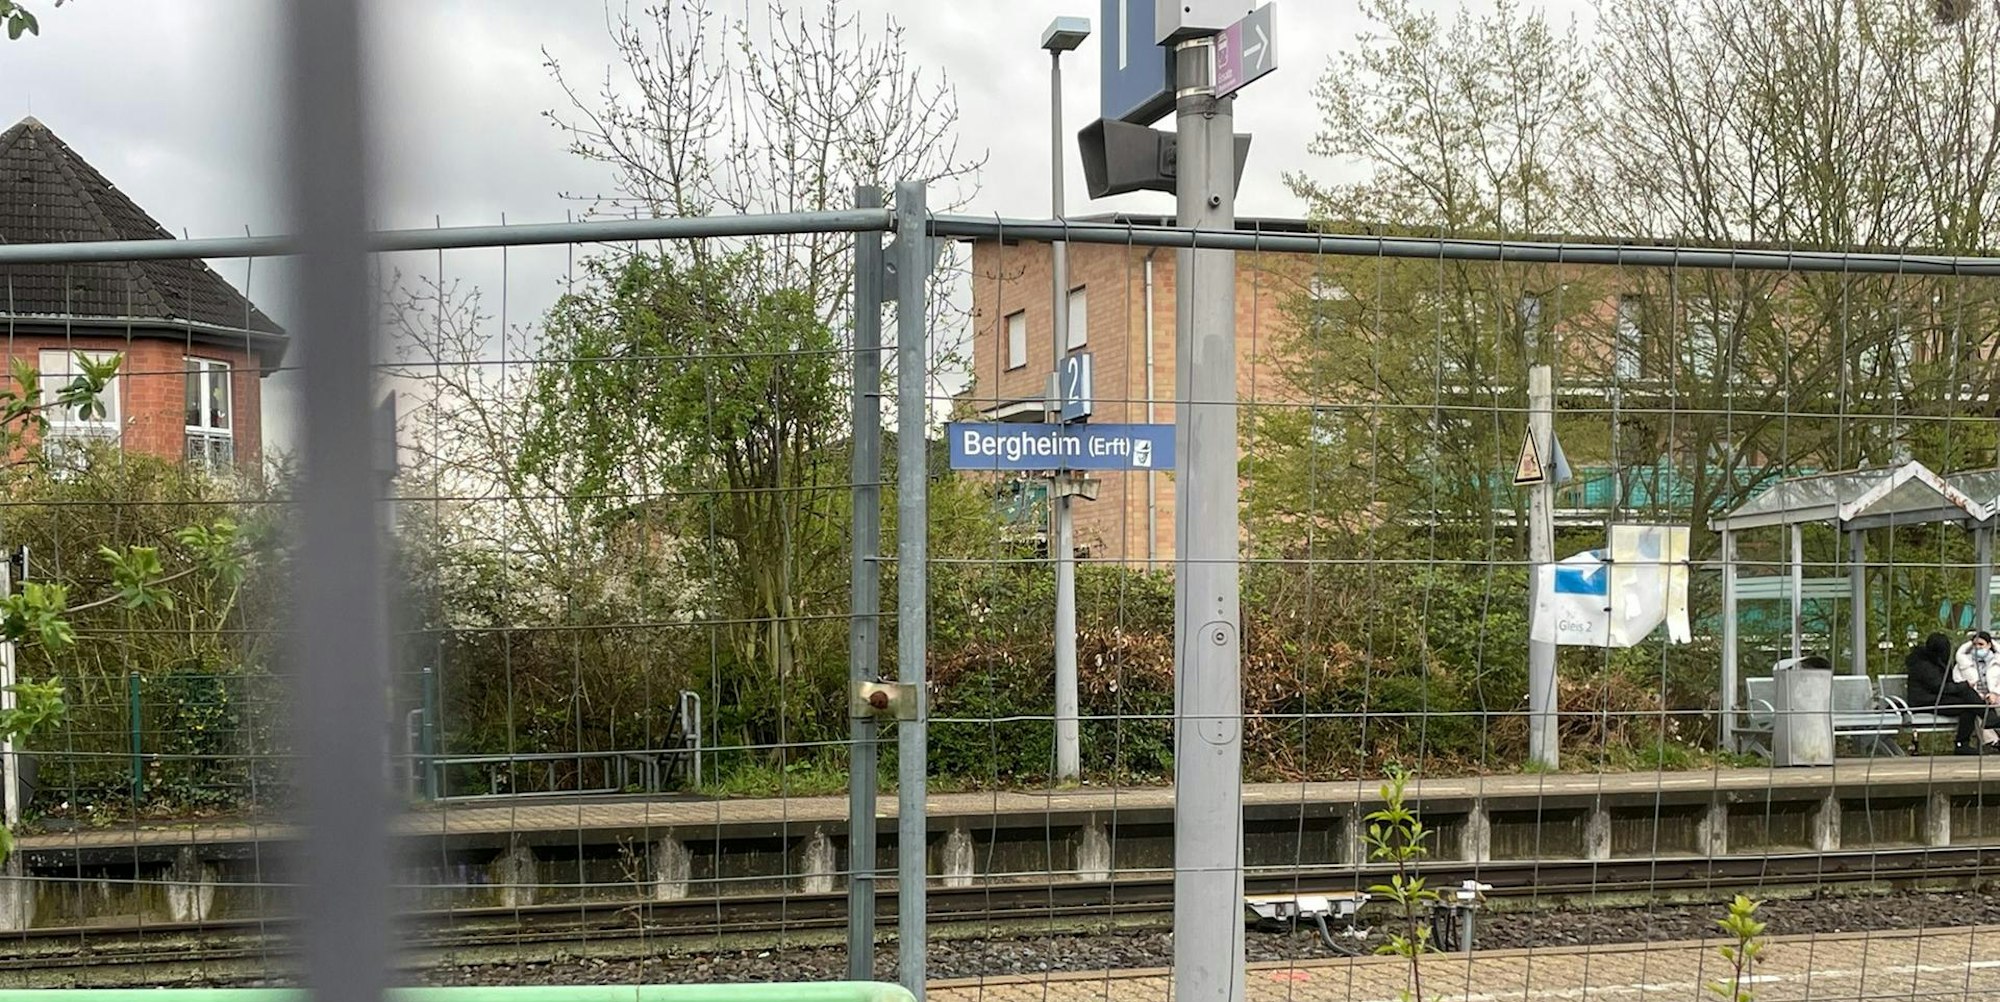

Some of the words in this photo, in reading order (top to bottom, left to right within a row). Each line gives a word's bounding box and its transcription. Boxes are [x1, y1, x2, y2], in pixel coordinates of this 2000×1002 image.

[1067, 357, 1079, 405] 2
[964, 432, 1080, 461] Bergheim
[1089, 436, 1131, 456] (Erft)
[1586, 621, 1593, 632] 2
